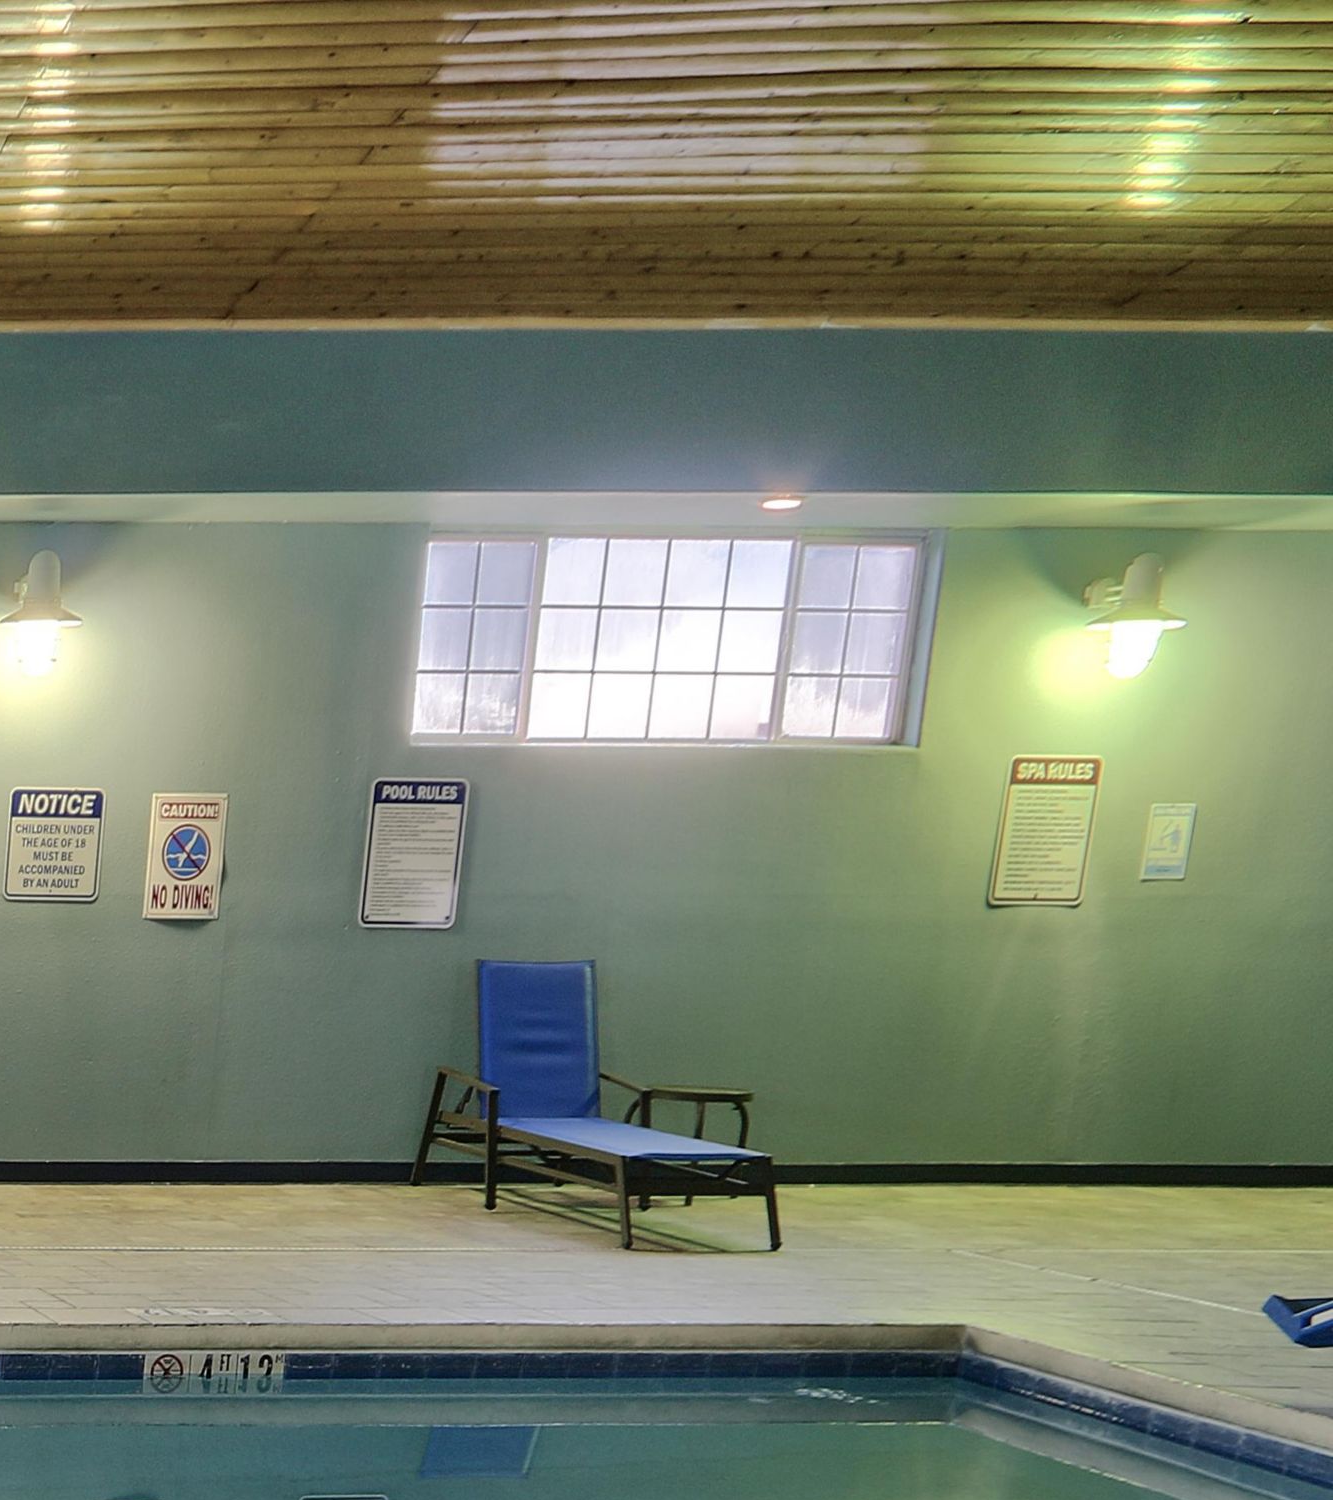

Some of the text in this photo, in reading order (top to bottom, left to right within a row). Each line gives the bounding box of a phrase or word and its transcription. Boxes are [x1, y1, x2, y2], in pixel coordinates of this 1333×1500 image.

[1016, 762, 1094, 780] SPA RULES
[382, 785, 458, 800] POOL RULES
[18, 793, 96, 815] NOTICE
[161, 804, 219, 818] CAUTION!
[15, 824, 94, 835] CHILDREN UNDER
[22, 838, 86, 848] THE AGE OF 18
[33, 851, 74, 861] MUST BE
[18, 865, 85, 875] ACCOMPANIED
[22, 878, 79, 888] BY AN ADULT
[151, 884, 214, 909] NO DIVING!
[199, 1354, 213, 1379] 4
[220, 1354, 231, 1371] FT
